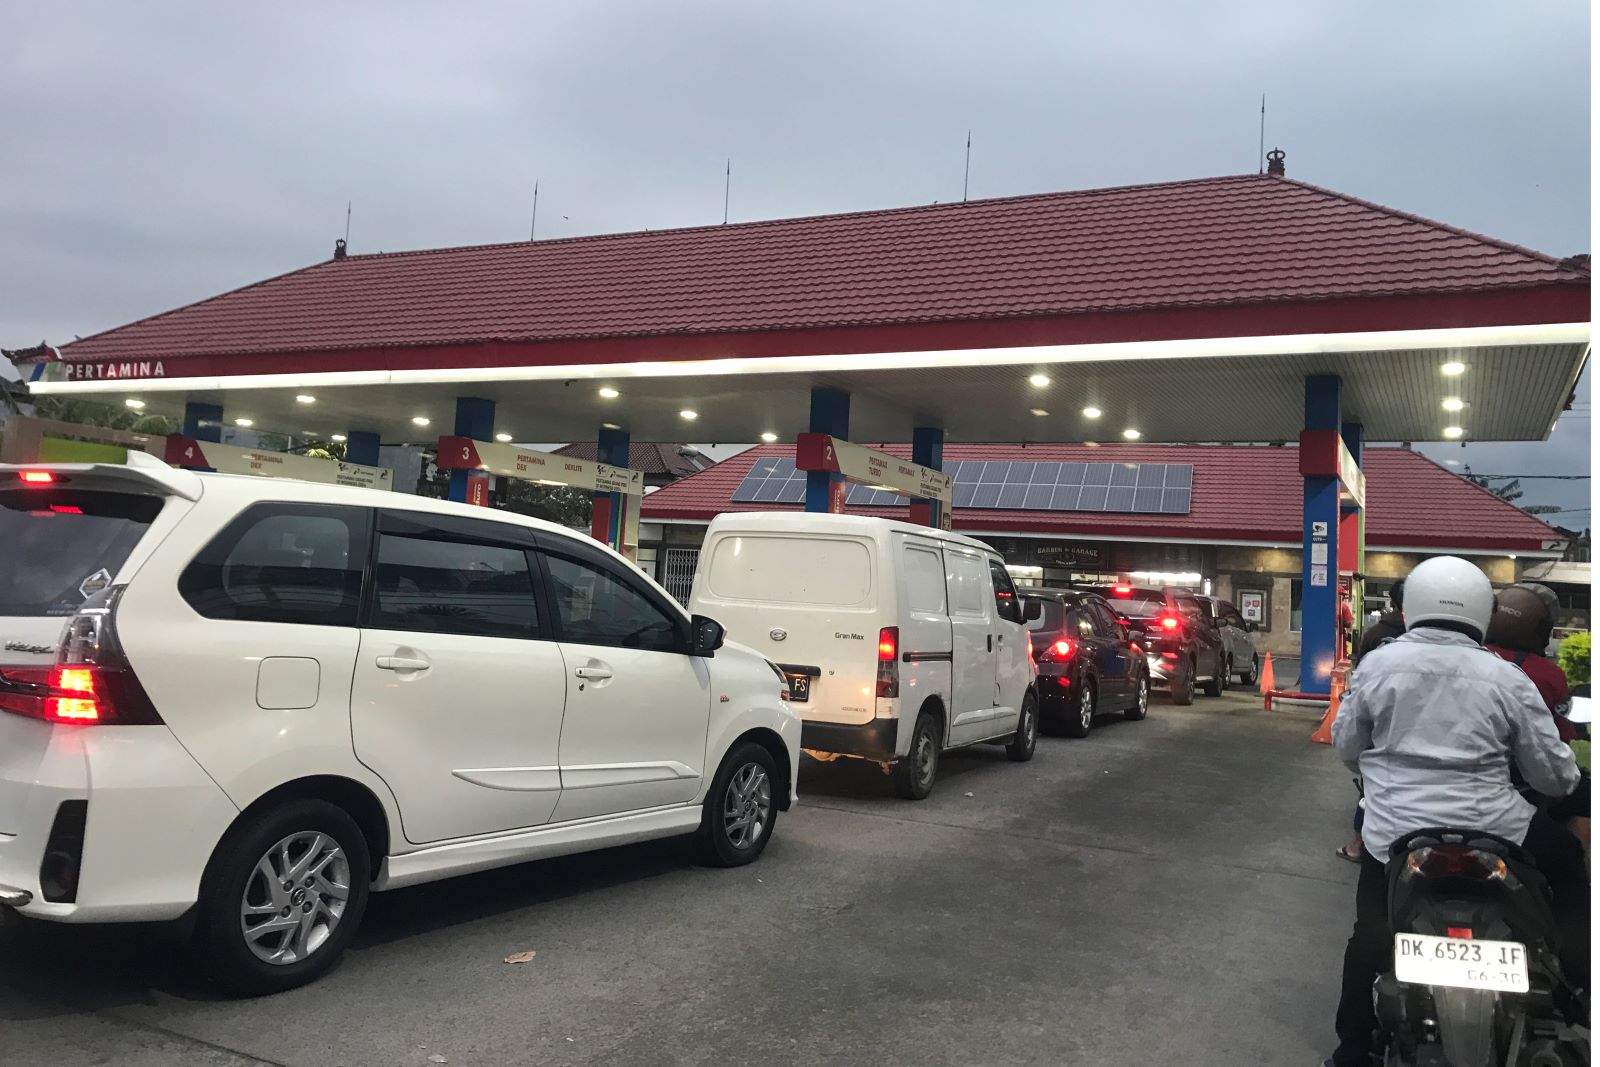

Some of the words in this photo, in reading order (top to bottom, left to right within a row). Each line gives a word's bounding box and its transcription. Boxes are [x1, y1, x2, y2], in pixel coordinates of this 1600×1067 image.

[65, 361, 165, 378] PERTAMINA
[184, 446, 194, 460] 4
[462, 446, 470, 460] 3
[516, 454, 546, 466] PERTAMINA
[826, 446, 832, 461] 2
[516, 463, 527, 472] DEX
[564, 463, 583, 472] DEXLITE
[834, 632, 850, 640] Gran
[850, 633, 865, 641] Max
[794, 678, 806, 692] FS
[1400, 938, 1424, 957] DK
[1435, 942, 1482, 962] 6523
